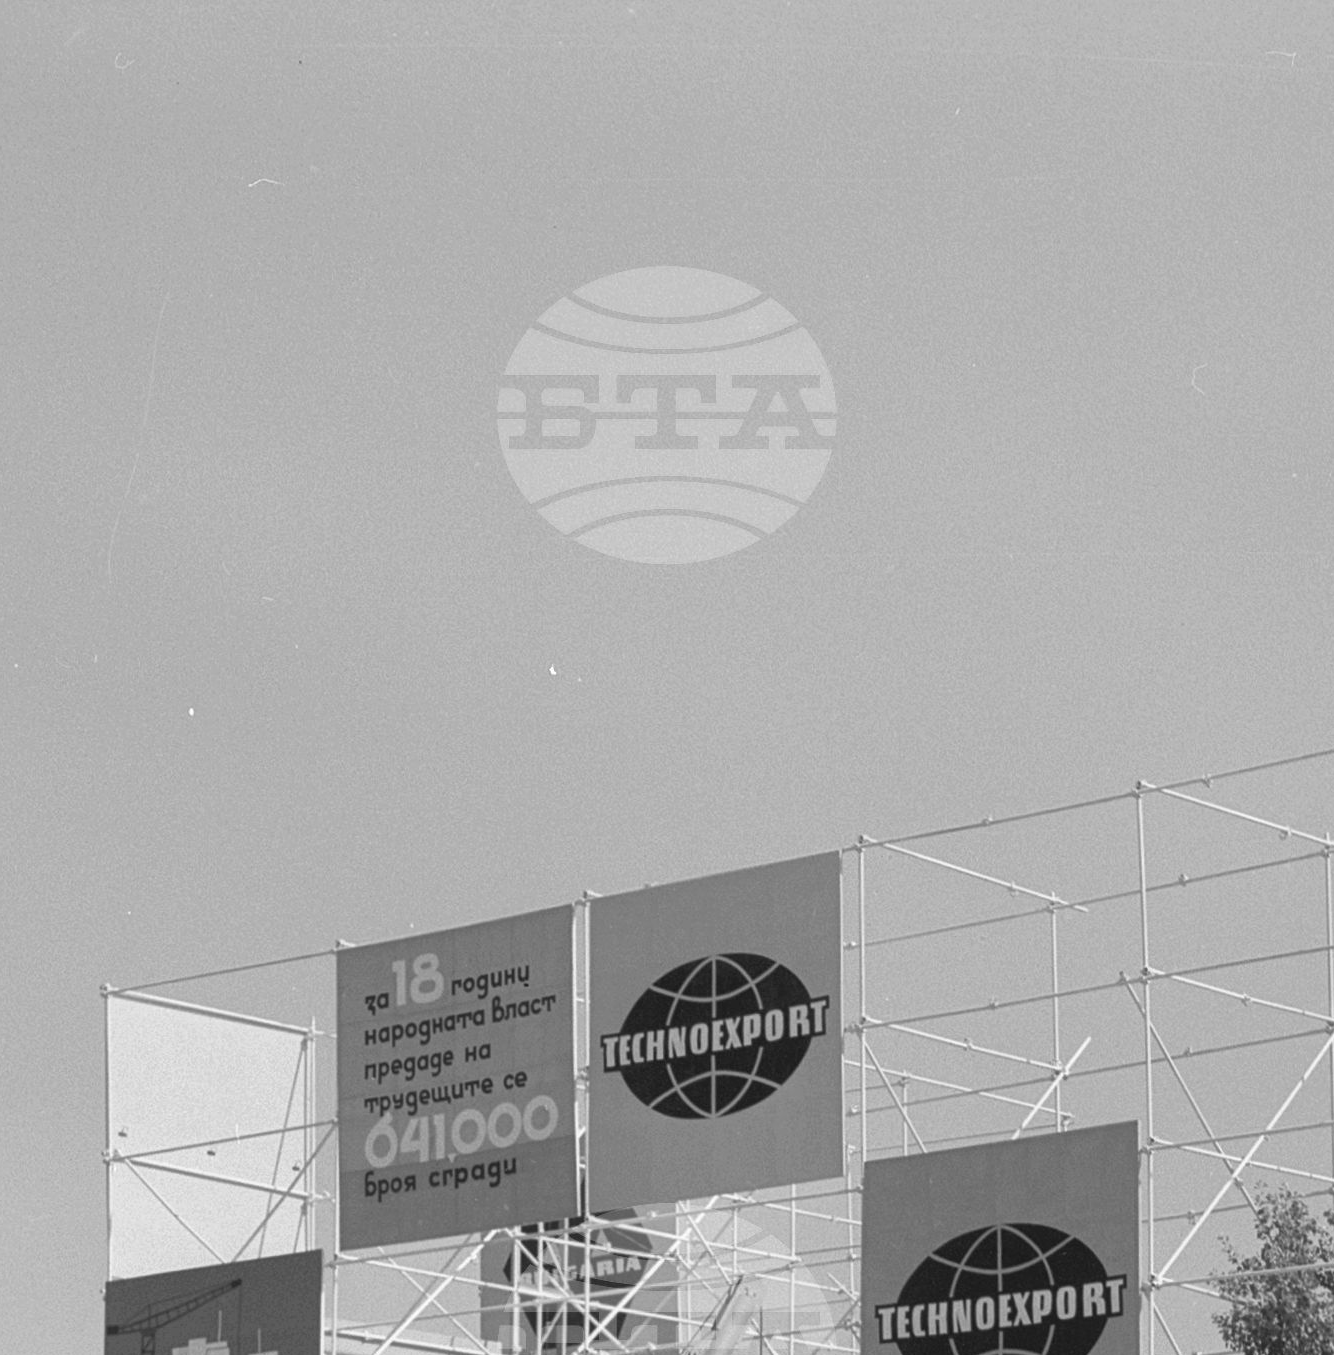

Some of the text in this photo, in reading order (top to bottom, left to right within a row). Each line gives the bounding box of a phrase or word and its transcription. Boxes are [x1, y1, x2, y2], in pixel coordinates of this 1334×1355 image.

[364, 992, 389, 1016] за
[391, 952, 445, 1007] 18
[364, 994, 557, 1048] народната власт
[602, 1000, 827, 1068] TECHNOEXPORT
[364, 1043, 492, 1085] предаде на
[363, 1070, 528, 1116] трудещите се
[364, 1157, 517, 1203] броя сгради
[878, 1277, 1125, 1342] TECHNOEXPORT
